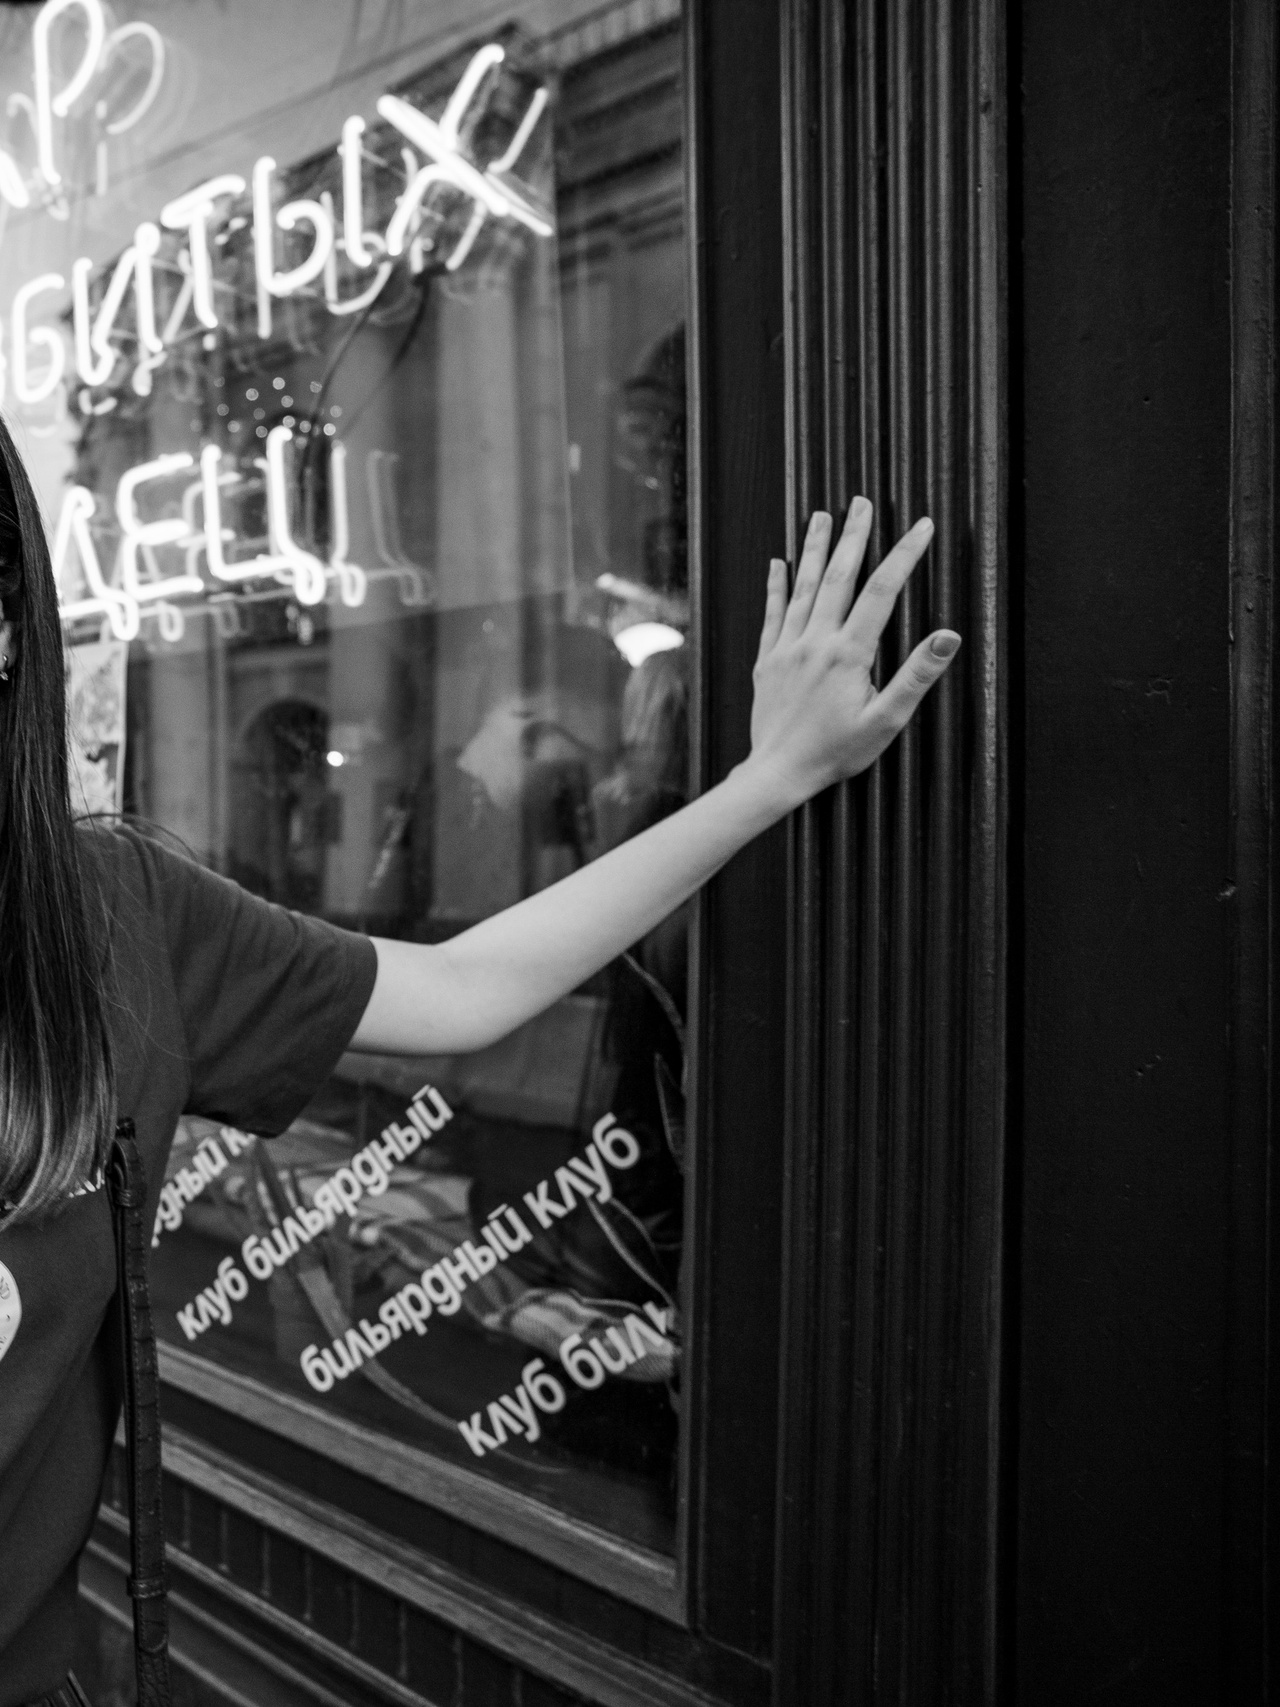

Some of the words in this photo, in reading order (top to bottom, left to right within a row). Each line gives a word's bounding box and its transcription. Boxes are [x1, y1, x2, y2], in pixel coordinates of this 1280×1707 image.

[54, 425, 323, 642] ДЕЦ
[151, 1136, 228, 1248] дный
[176, 1256, 249, 1341] клуб
[241, 1084, 454, 1280] бильярдный
[300, 1203, 534, 1392] бильярдный
[523, 1112, 641, 1230] клуб
[457, 1358, 566, 1457] клуб
